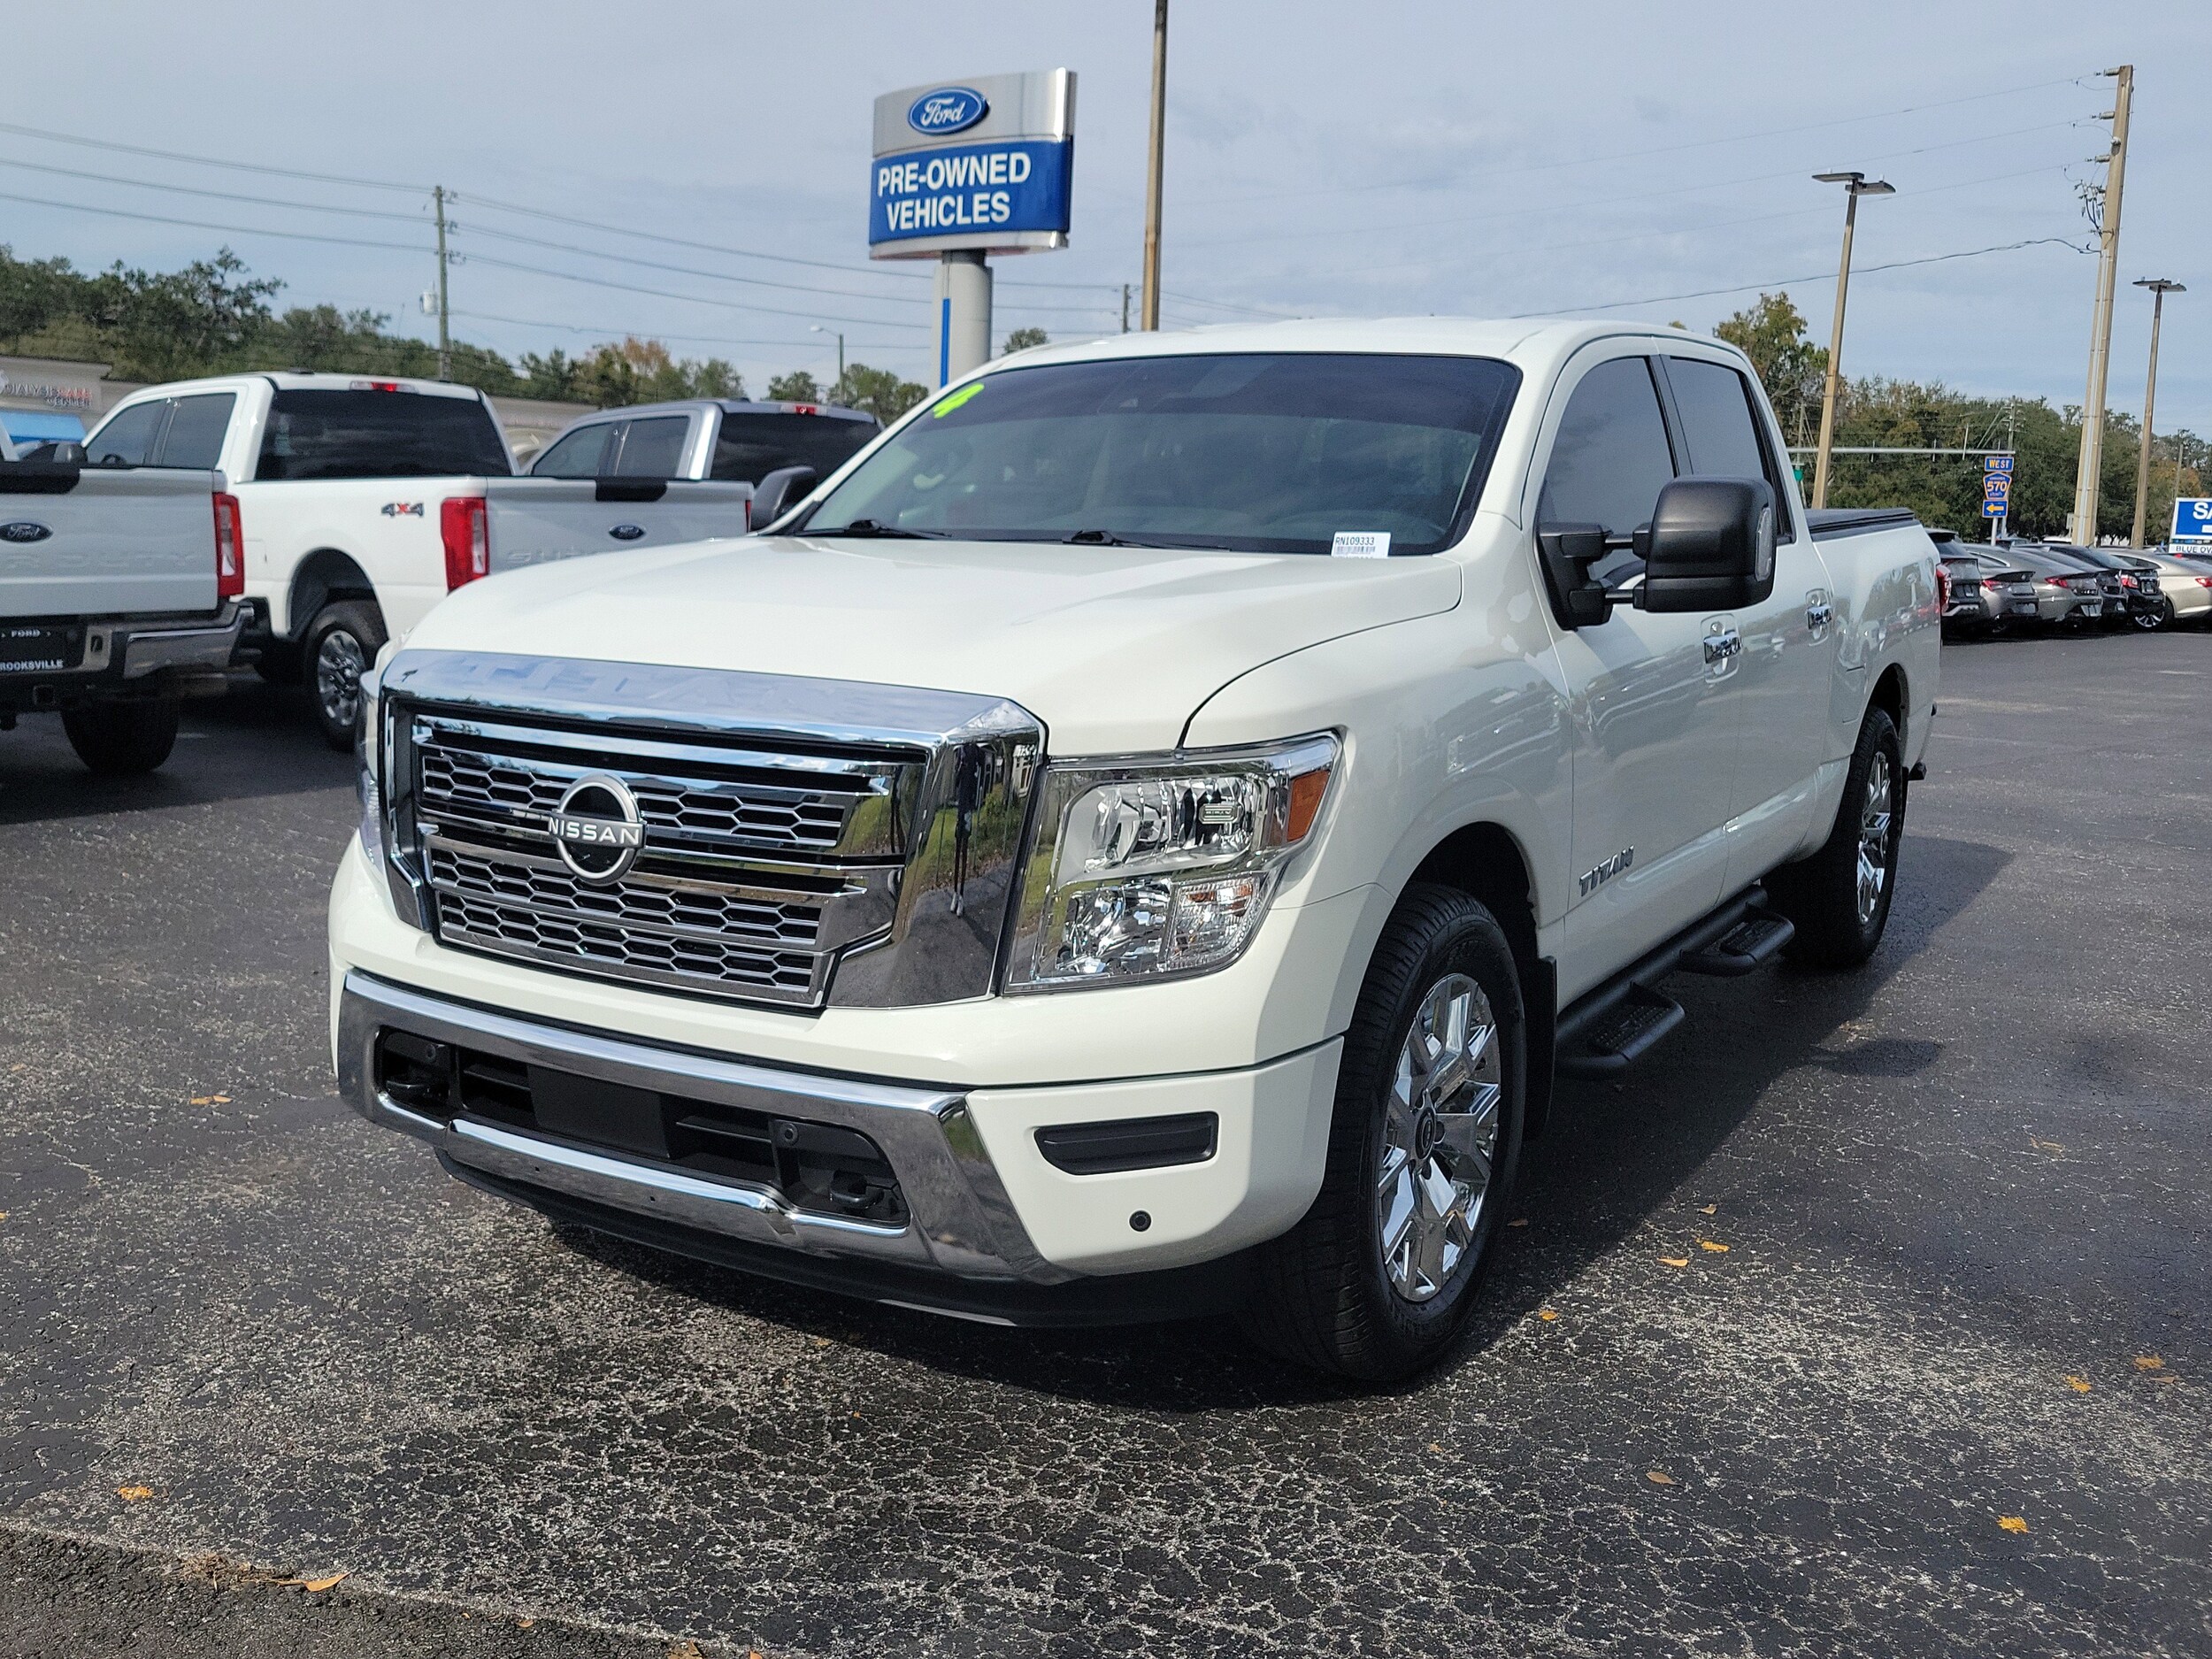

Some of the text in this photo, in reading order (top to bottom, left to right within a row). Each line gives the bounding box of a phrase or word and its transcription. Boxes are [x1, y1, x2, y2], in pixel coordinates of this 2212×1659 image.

[920, 97, 966, 127] Ford
[878, 151, 1032, 197] PRE-OWNED
[887, 191, 1010, 233] VEHICLES
[1989, 458, 2009, 469] WEST
[1987, 480, 2008, 492] 570
[1335, 536, 1375, 546] RN109333
[548, 817, 640, 846] NISSAN
[1578, 844, 1634, 897] TITAN
